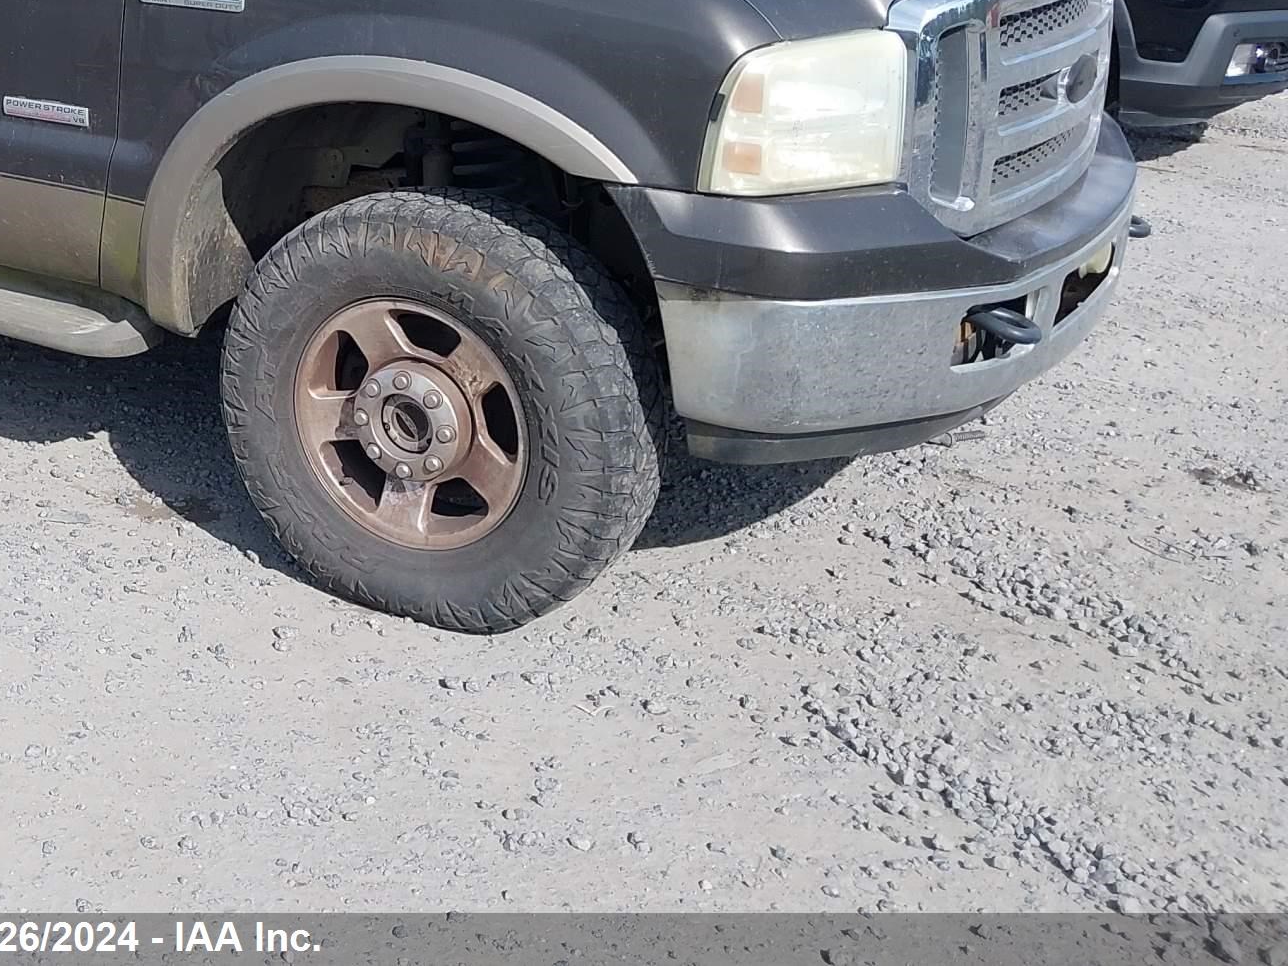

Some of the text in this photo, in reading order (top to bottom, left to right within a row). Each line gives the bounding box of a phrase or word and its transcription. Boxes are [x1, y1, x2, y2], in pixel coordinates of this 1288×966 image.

[183, 0, 214, 8] SUPER
[215, 3, 241, 11] DUTY
[6, 98, 85, 116] POWER STROKE
[73, 116, 86, 124] V8
[430, 280, 561, 507] MAXXIS
